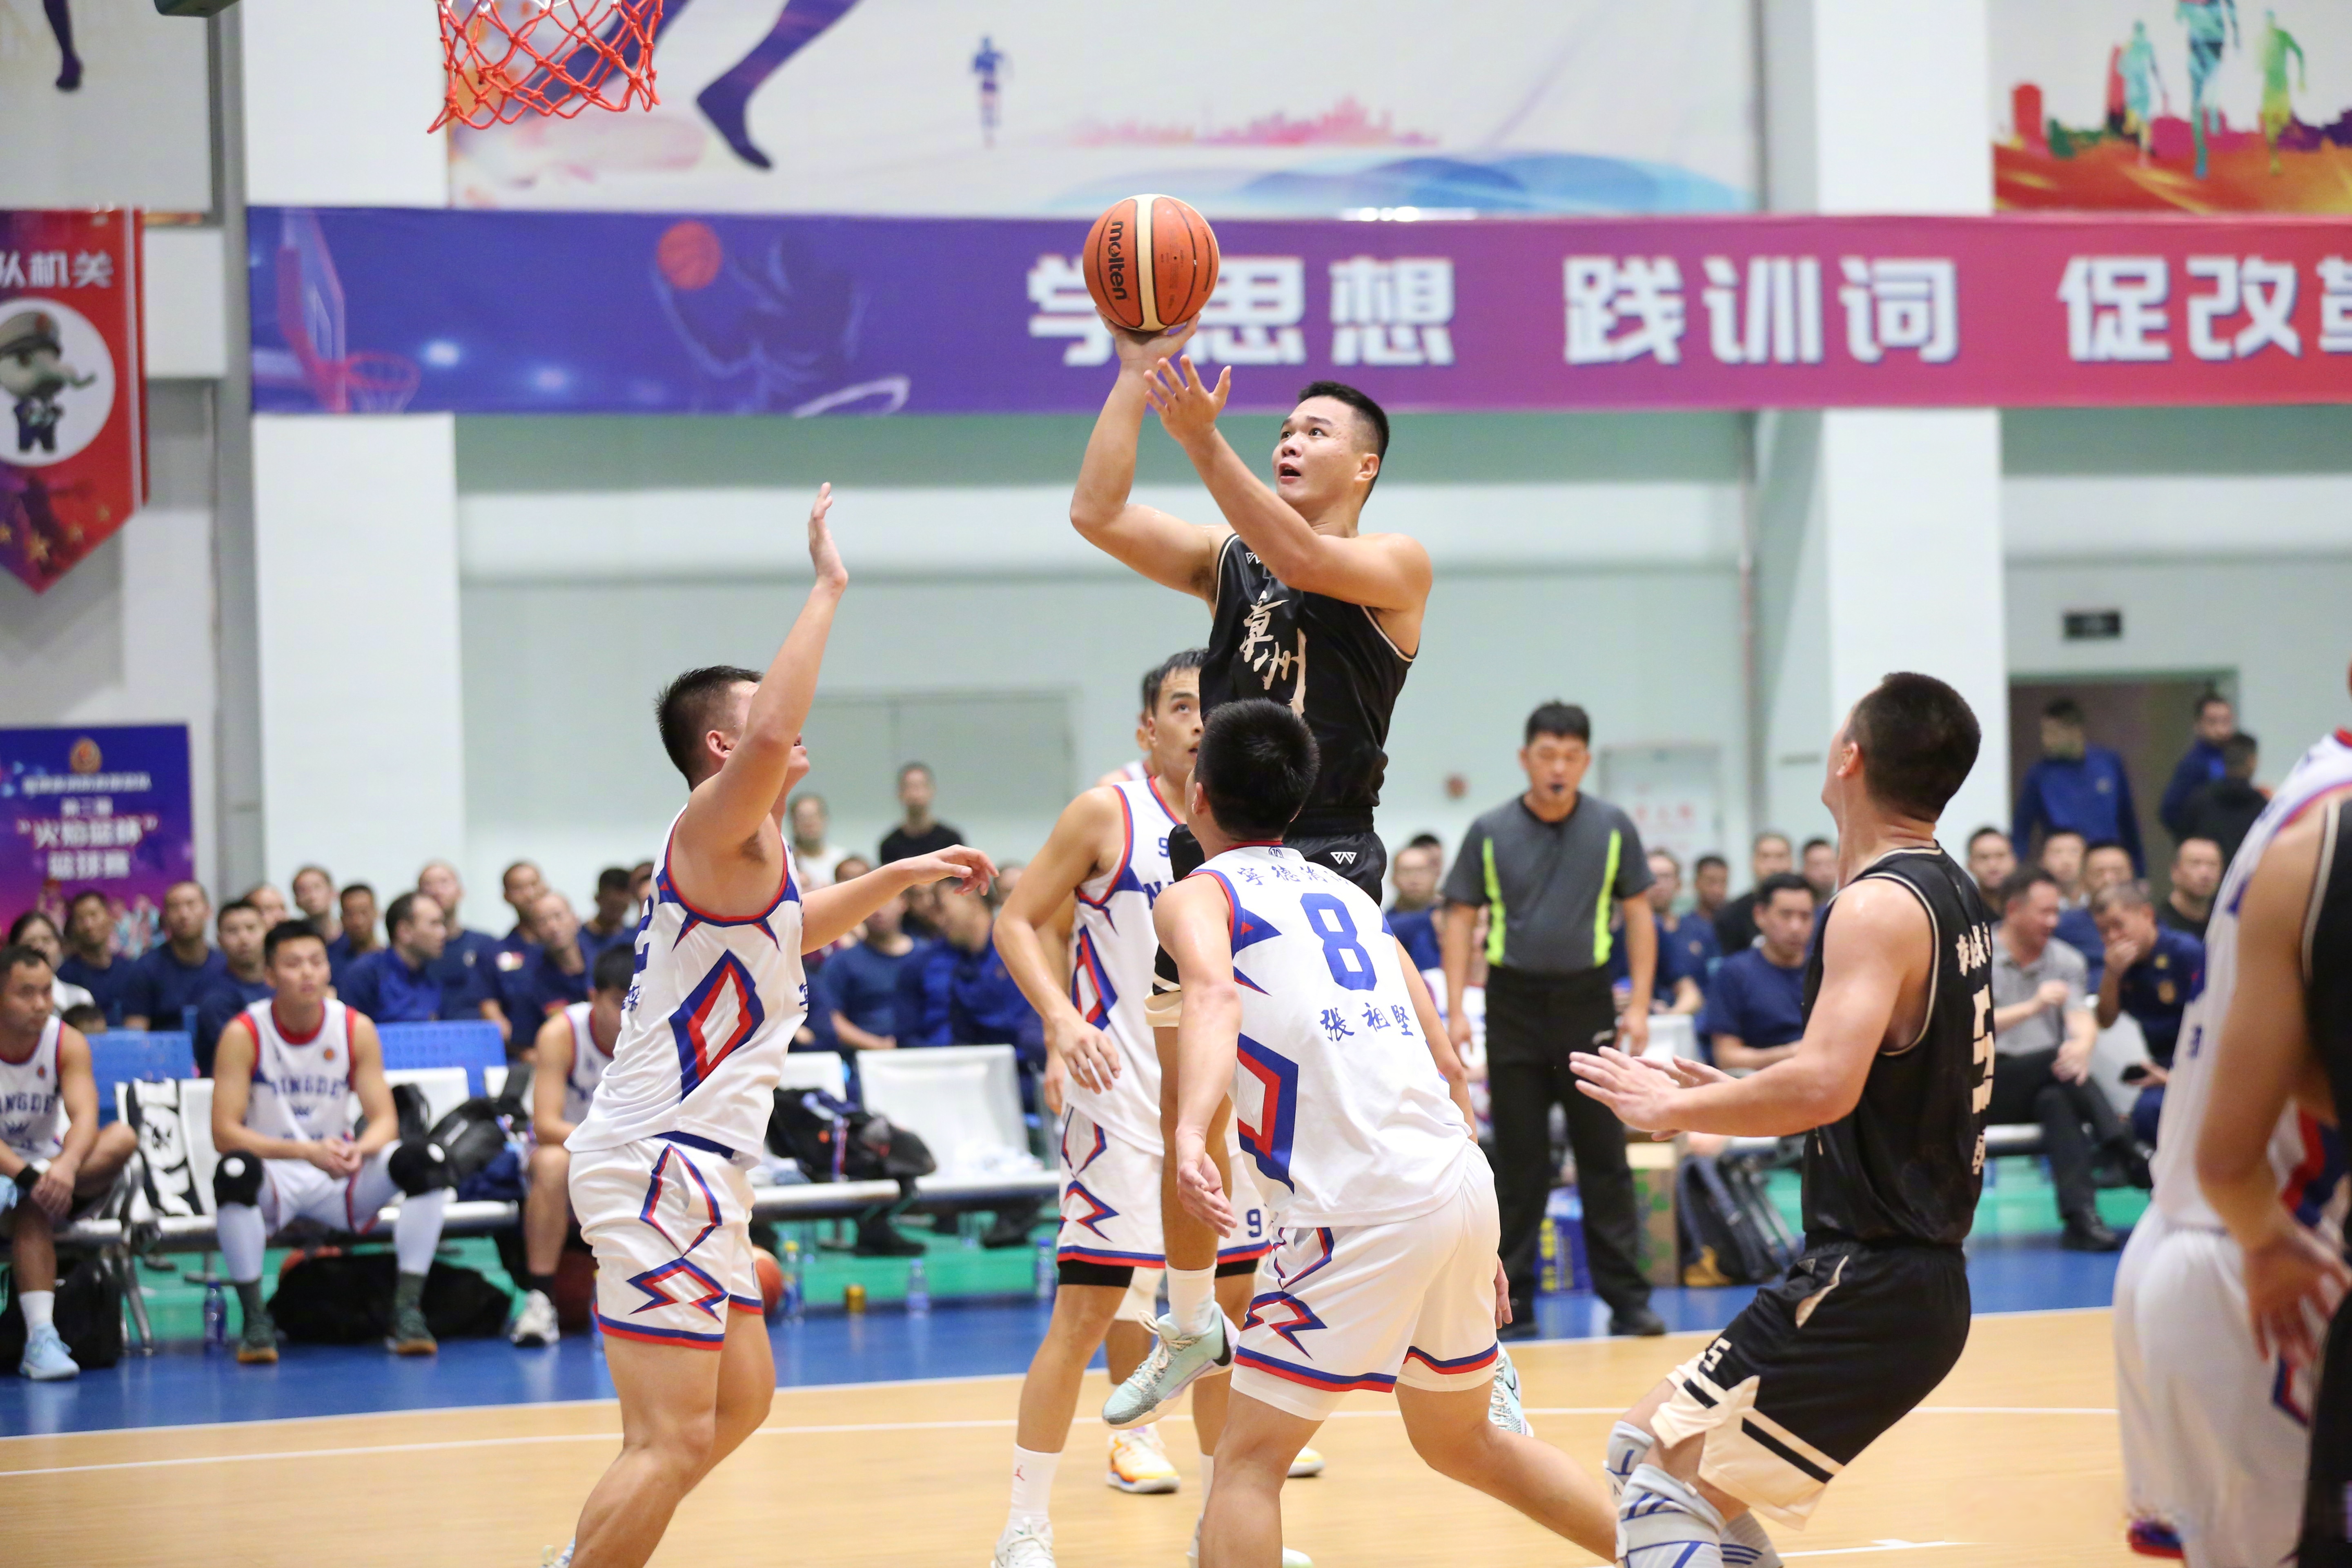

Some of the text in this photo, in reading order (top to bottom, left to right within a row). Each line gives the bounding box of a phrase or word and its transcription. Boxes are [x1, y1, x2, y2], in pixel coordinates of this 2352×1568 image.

[1107, 221, 1129, 300] molten
[1562, 255, 1959, 365] 践训词
[1300, 893, 1377, 991] 8
[1246, 1209, 1262, 1237] 9
